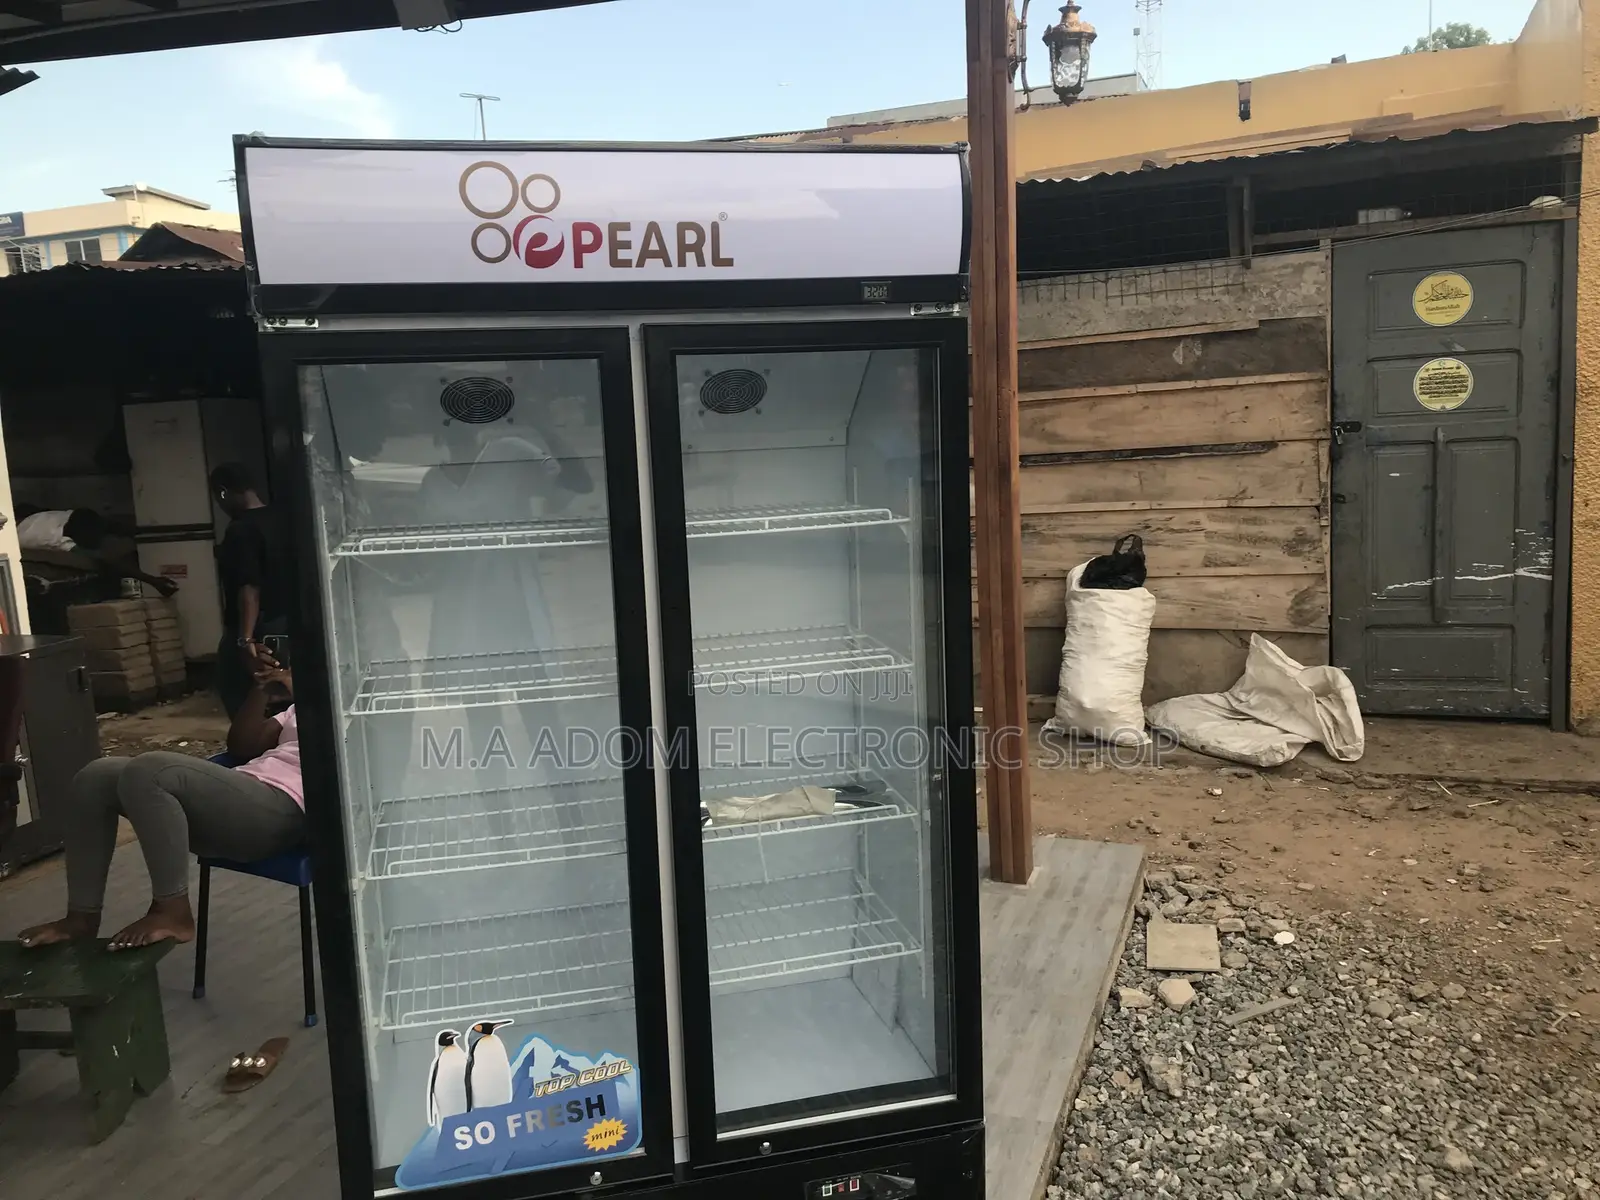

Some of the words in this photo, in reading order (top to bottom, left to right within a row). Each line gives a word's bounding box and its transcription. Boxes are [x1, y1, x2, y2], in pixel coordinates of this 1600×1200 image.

[571, 220, 735, 269] PEARL
[534, 1072, 577, 1098] TOP
[577, 1058, 633, 1088] COOL
[453, 1120, 496, 1150] SO
[506, 1093, 606, 1138] FRESH
[591, 1125, 621, 1141] mini
